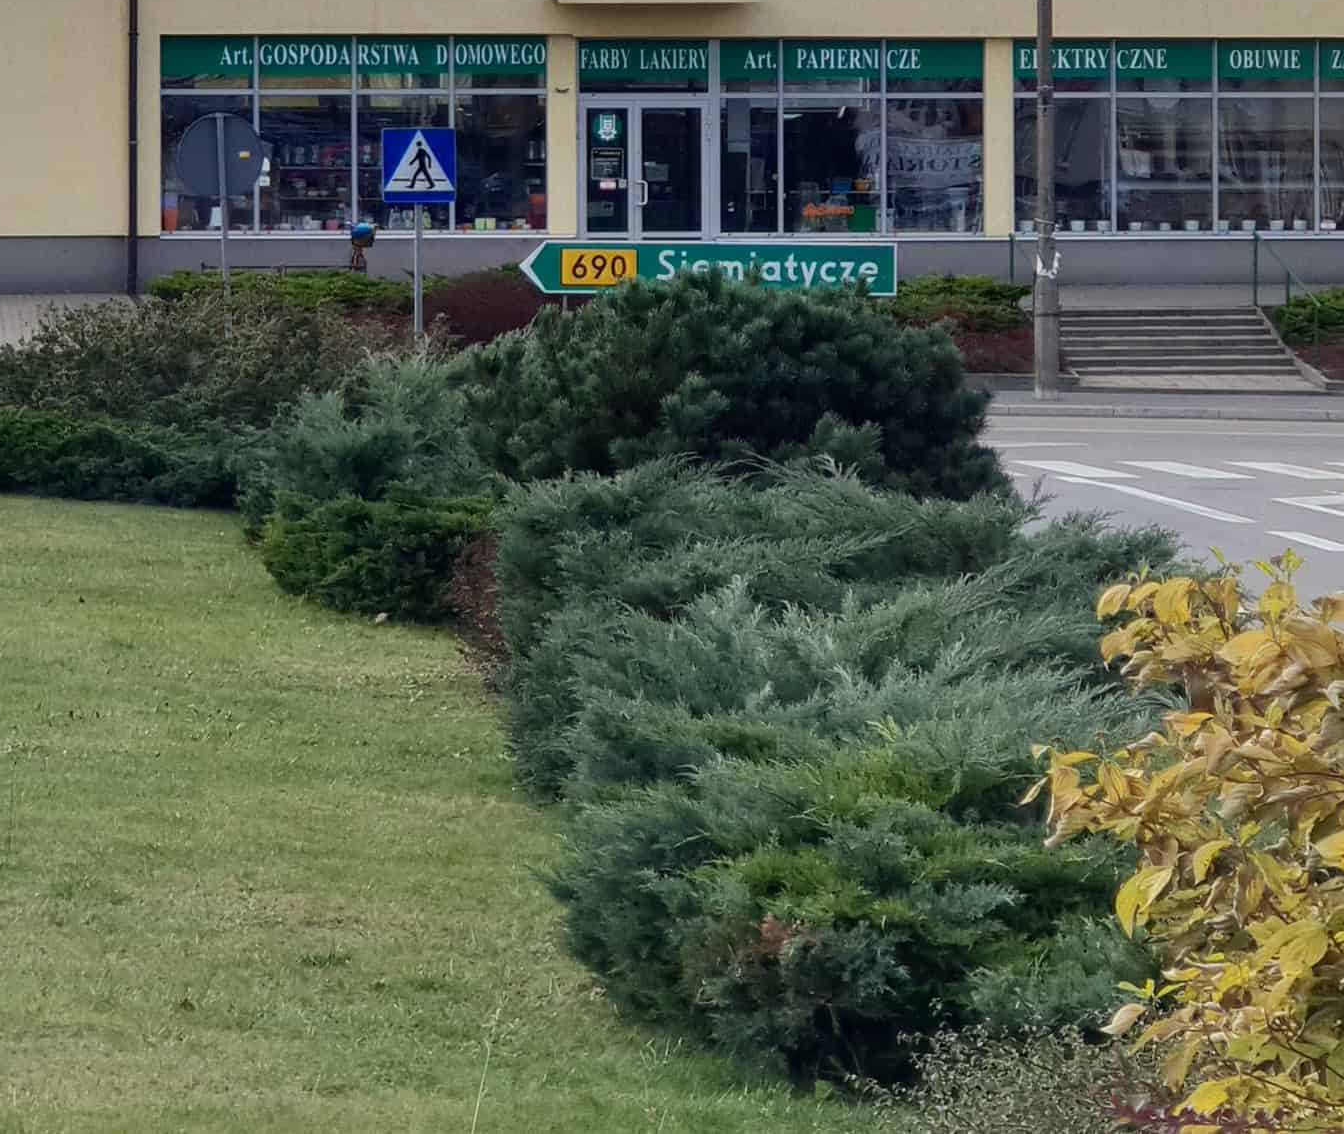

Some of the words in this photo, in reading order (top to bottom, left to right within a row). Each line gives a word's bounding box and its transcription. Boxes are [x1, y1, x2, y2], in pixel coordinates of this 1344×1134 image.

[220, 44, 254, 66] Art.
[259, 43, 420, 66] GOSPODARSTWA
[436, 43, 546, 66] DOMOWEGO
[580, 48, 631, 70] FARBY
[639, 48, 708, 70] LAKIERY
[743, 49, 777, 70] Art.
[796, 49, 921, 70] PAPIERNICZE
[1019, 48, 1168, 70] ELKTRYCZNE
[1229, 49, 1301, 70] OBUWIE
[571, 253, 627, 279] 690
